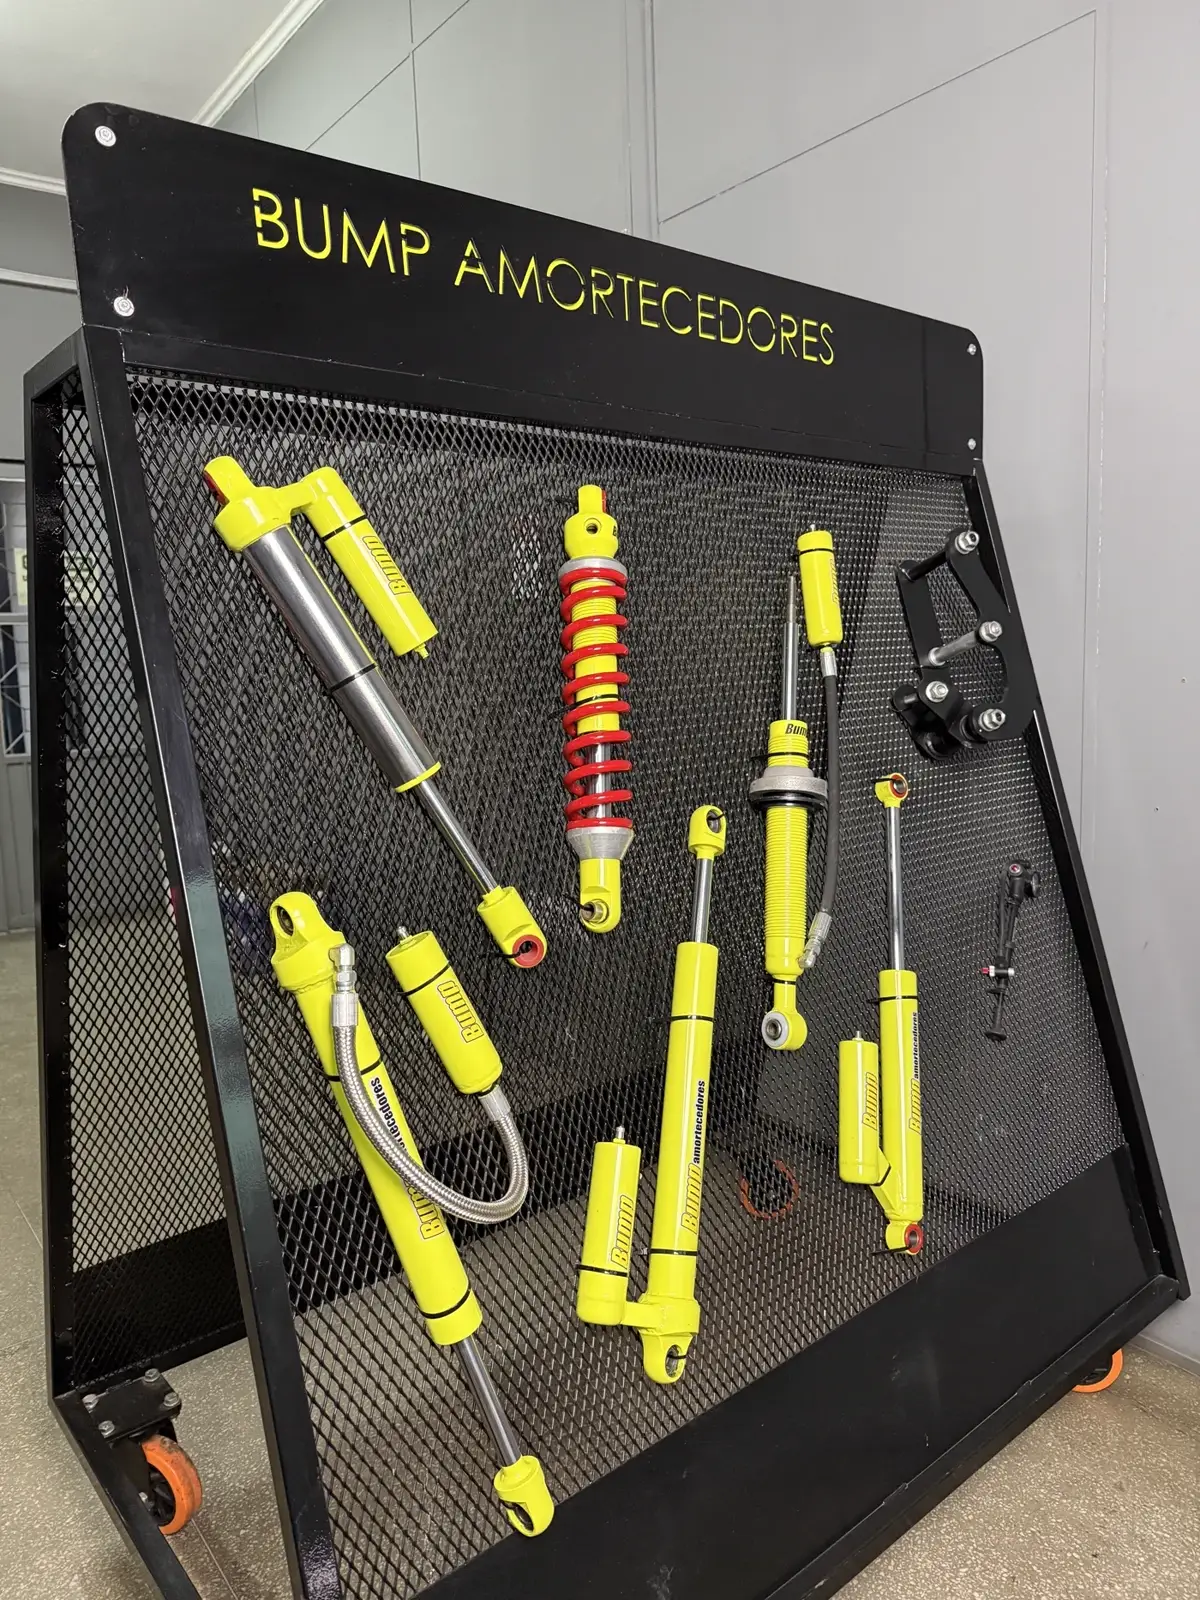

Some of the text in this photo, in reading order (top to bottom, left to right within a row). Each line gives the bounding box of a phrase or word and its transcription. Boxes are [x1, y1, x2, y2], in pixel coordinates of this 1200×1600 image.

[252, 187, 836, 367] BUMP AMORTECEDORES
[692, 1080, 706, 1164] amortecedores
